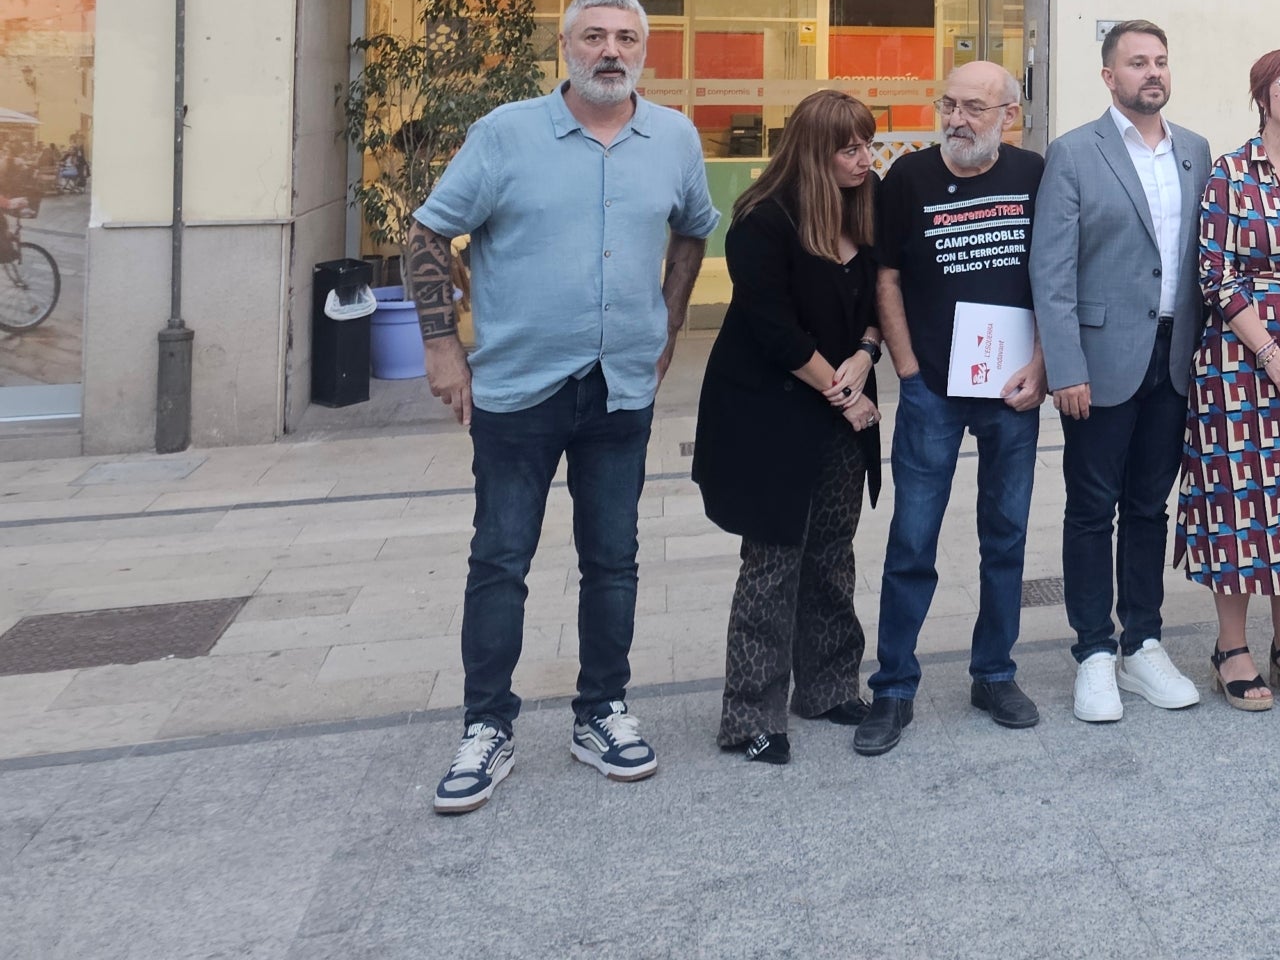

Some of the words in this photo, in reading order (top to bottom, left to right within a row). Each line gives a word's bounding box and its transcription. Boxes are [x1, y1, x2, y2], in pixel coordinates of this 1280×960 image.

[933, 204, 1024, 226] #QueremosTREN
[935, 229, 1026, 250] CAMPORROBLES
[936, 252, 956, 263] CON
[957, 251, 969, 261] EL
[969, 244, 1026, 259] FERROCARRIL
[943, 261, 983, 275] PÚBLICO
[984, 260, 991, 269] Y
[992, 257, 1021, 268] SOCIAL
